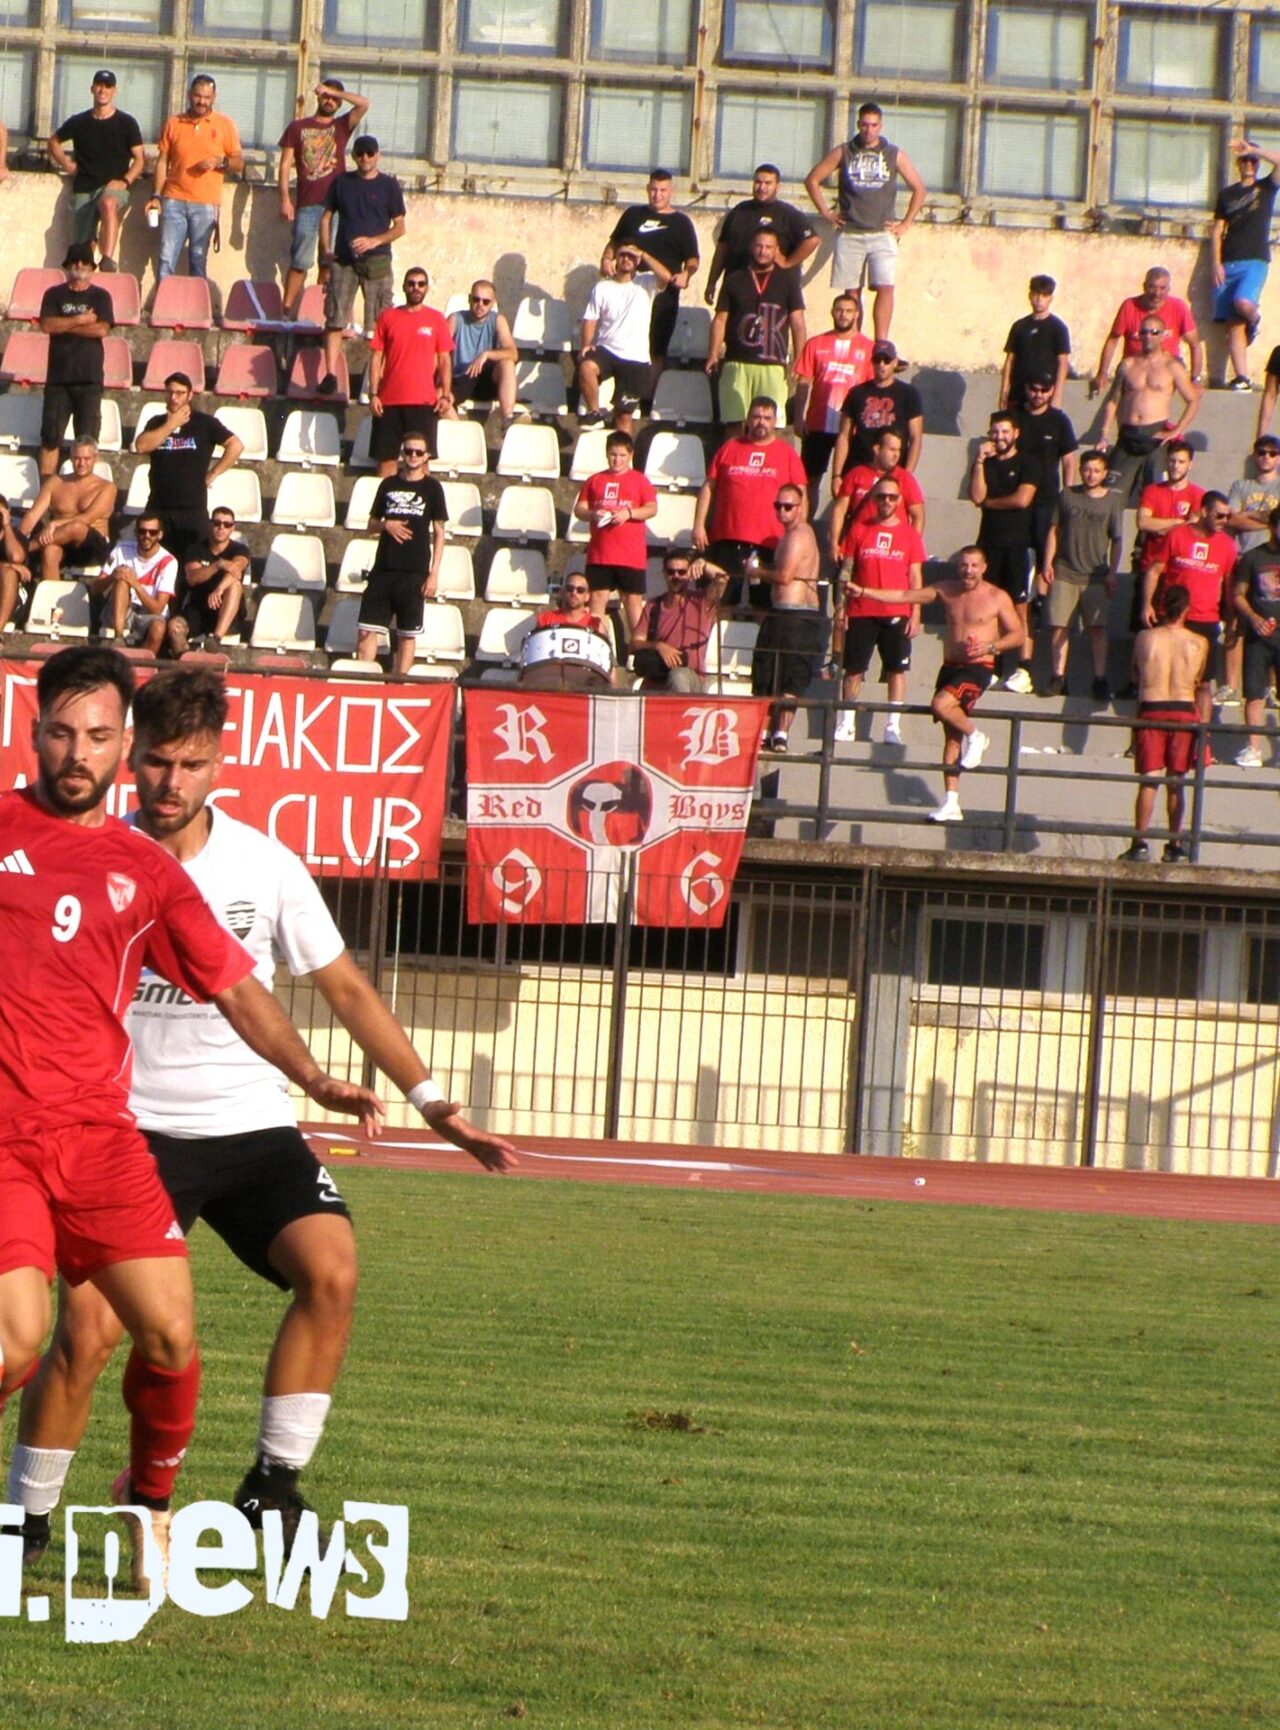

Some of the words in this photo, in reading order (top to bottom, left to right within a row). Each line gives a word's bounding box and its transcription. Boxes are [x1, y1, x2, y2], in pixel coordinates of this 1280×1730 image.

[493, 703, 556, 764] R
[678, 706, 740, 770] B
[268, 793, 422, 868] CLUB
[477, 794, 542, 818] Red
[668, 795, 746, 826] Boys
[492, 848, 542, 914] 9
[680, 851, 724, 915] 6
[51, 894, 82, 943] 9
